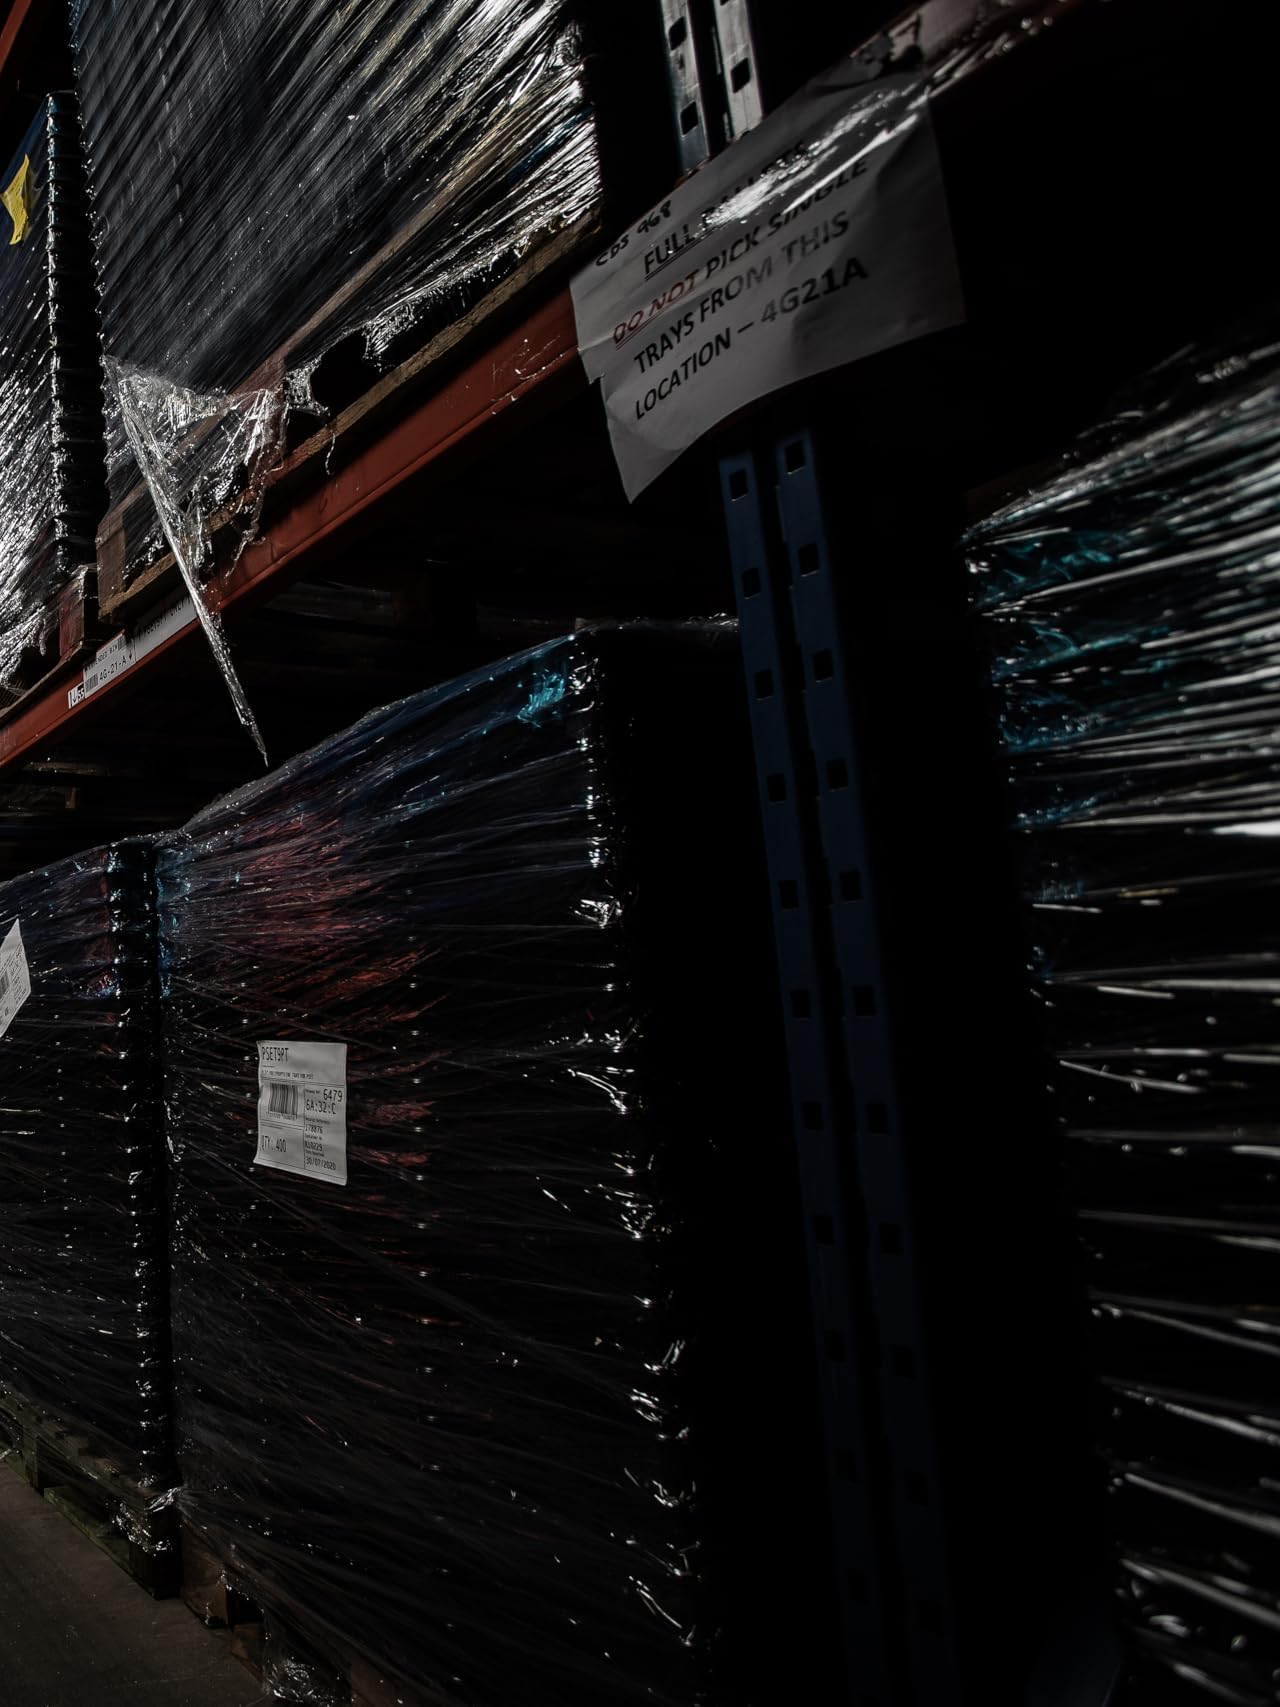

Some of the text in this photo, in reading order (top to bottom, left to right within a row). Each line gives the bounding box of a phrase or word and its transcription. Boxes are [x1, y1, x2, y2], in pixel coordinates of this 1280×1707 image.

[613, 310, 644, 344] DO
[648, 269, 699, 317] NOT
[705, 225, 761, 279] PICK
[633, 209, 850, 374] TRAYS FROM THIS
[644, 223, 695, 275] FULL
[635, 327, 731, 420] LOCATION
[760, 257, 868, 323] 4G21A
[323, 1088, 343, 1103] 6479
